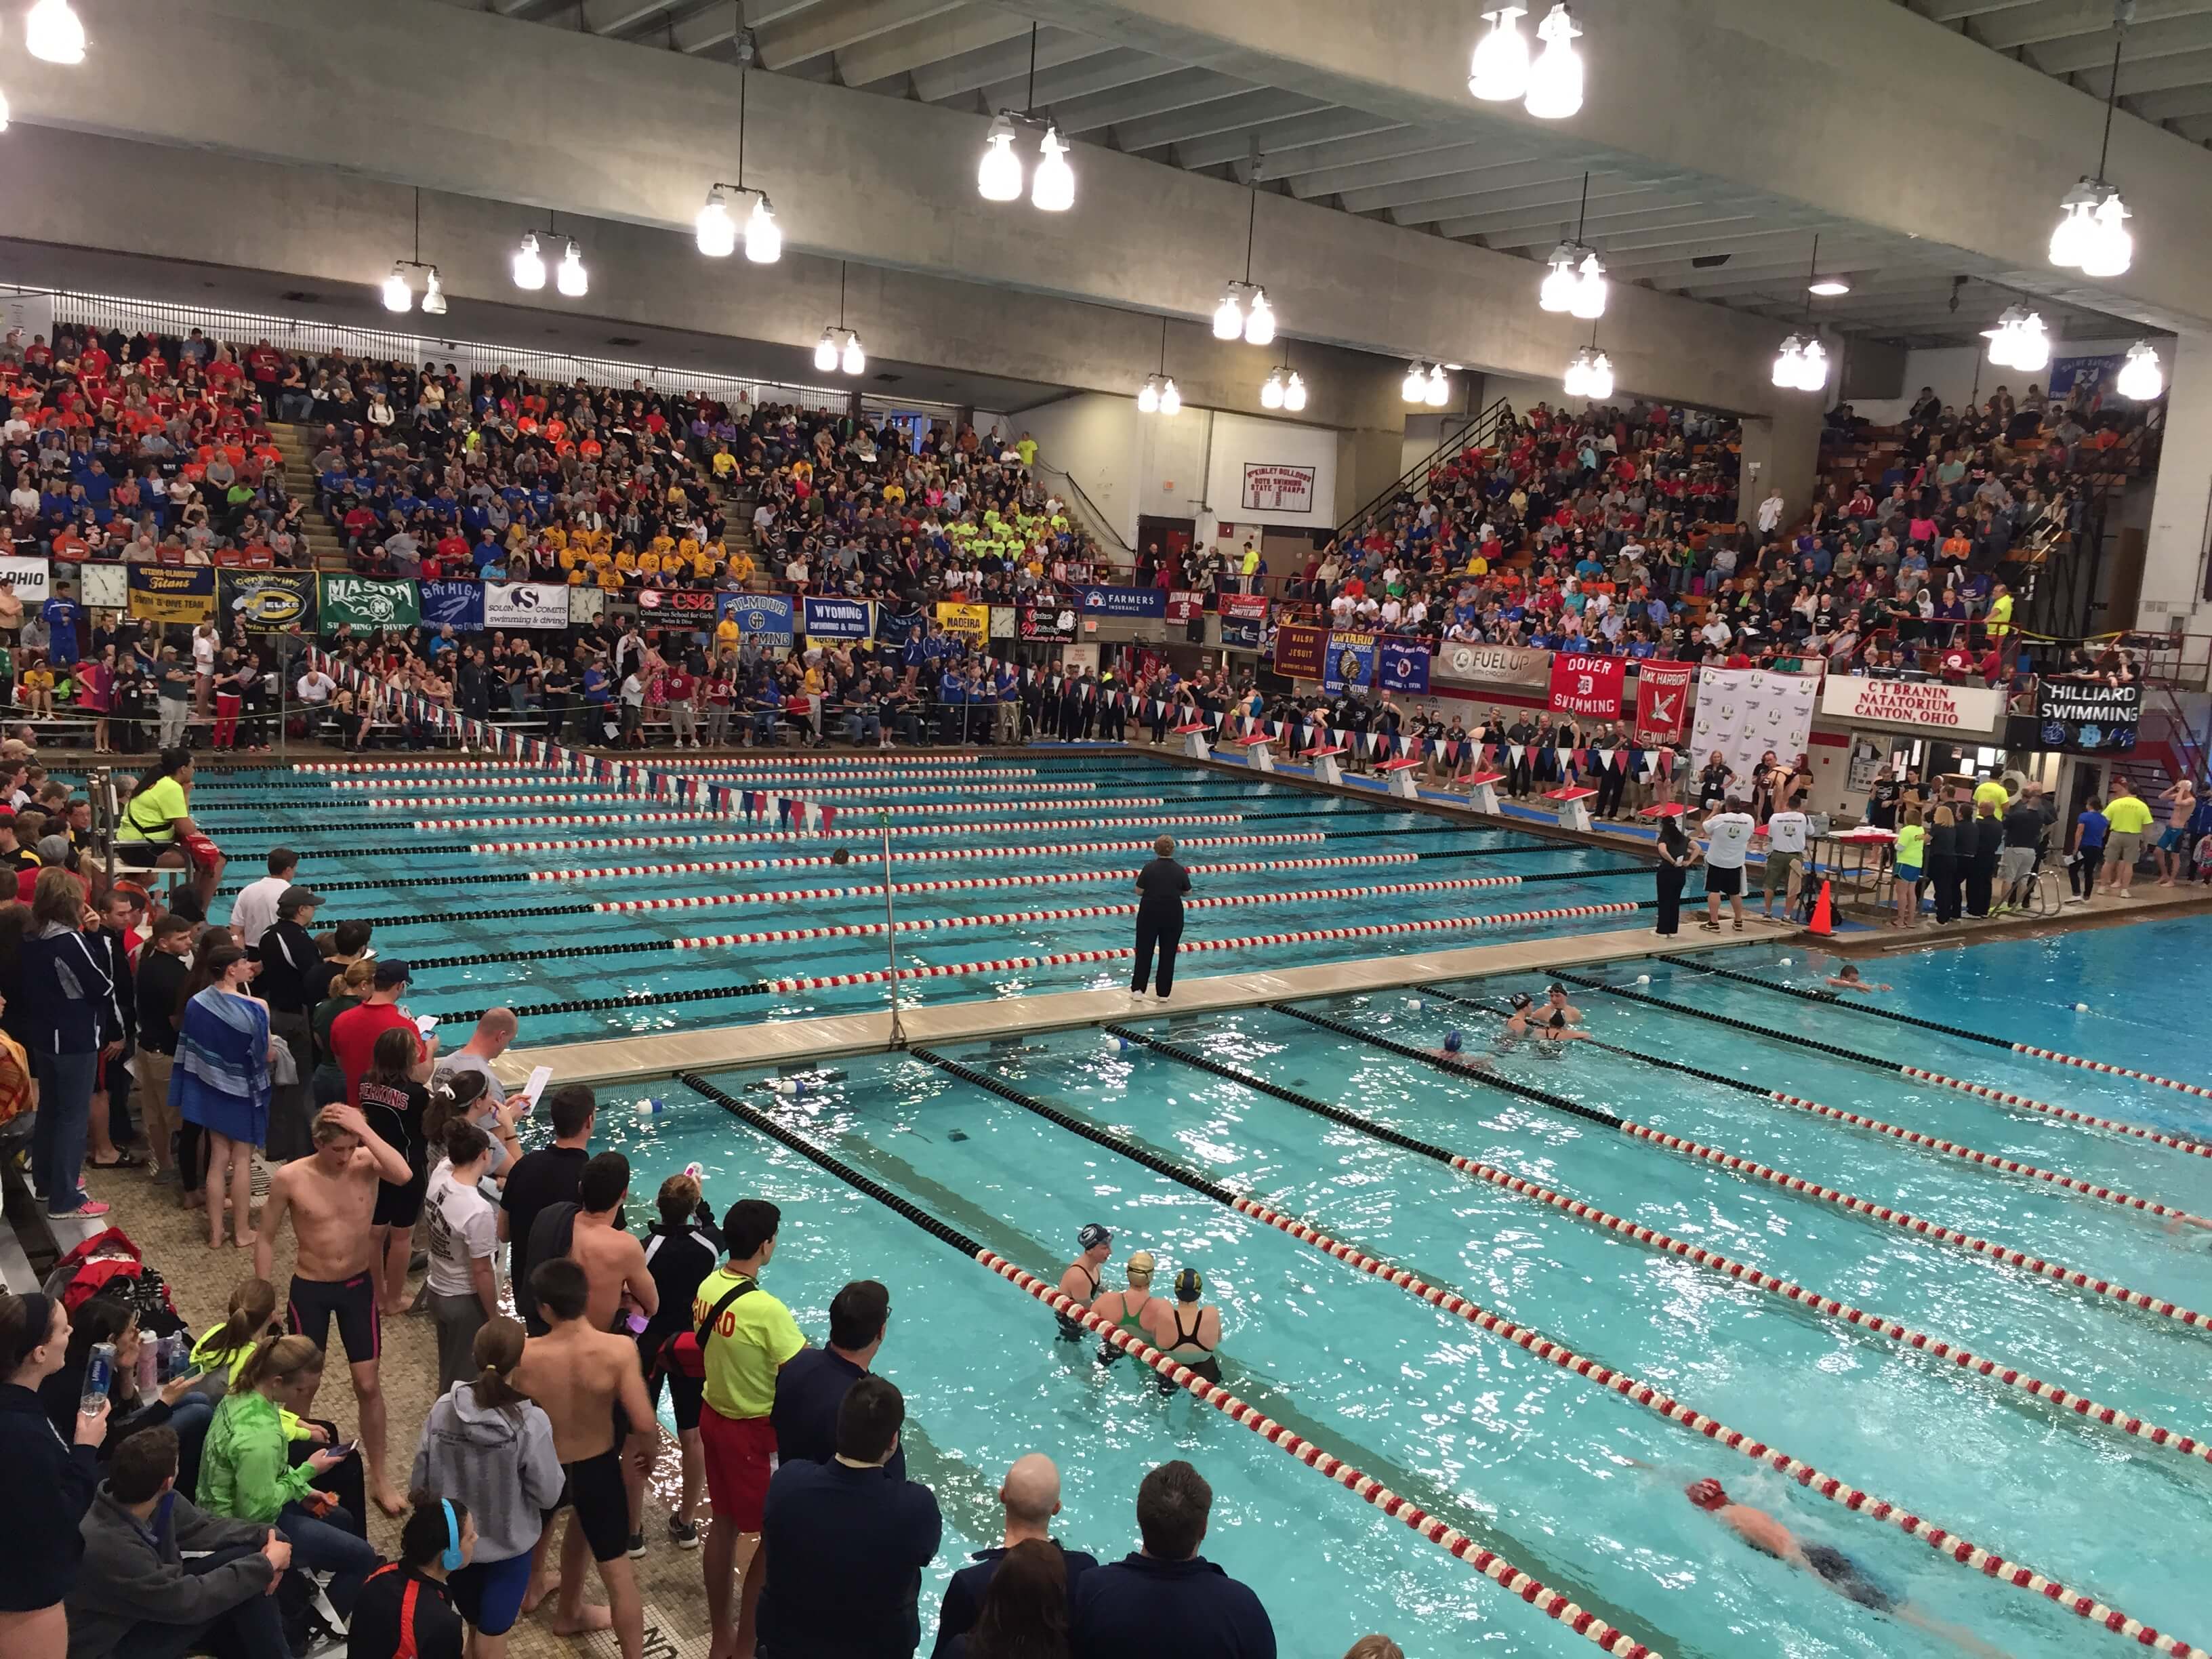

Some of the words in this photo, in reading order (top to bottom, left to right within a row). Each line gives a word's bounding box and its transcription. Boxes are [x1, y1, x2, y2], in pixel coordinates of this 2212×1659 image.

[1279, 468, 1311, 483] BULLDOGS
[1278, 486, 1305, 494] CHAMPS
[149, 577, 190, 589] Titans
[236, 574, 300, 587] Centerville
[327, 579, 413, 607] MASON
[421, 583, 445, 598] BAY
[448, 582, 481, 602] HIGH
[1109, 594, 1155, 605] FARMERS
[134, 595, 153, 606] SWIM
[165, 599, 182, 608] DIVE
[184, 600, 205, 609] TEAM
[672, 592, 716, 610] CSG
[815, 605, 862, 619] WYOMING
[489, 616, 531, 624] swimming
[540, 617, 566, 626] diving
[810, 621, 839, 631] SWIMMING
[947, 617, 980, 629] MADEIRA
[1292, 634, 1314, 643] WALSH
[1332, 632, 1374, 644] ONTARIO
[1288, 649, 1313, 658] JESUIT
[1330, 642, 1346, 650] HIGH
[1347, 643, 1372, 653] SCHOOL
[1473, 651, 1505, 670] FUEL
[1510, 654, 1530, 671] UP
[1568, 657, 1612, 675] DOVER
[1641, 670, 1656, 683] OAK
[1656, 672, 1687, 686] HARBOR
[1868, 681, 1877, 692] C
[1881, 682, 1889, 693] T
[1893, 683, 1949, 699] BRANIN
[2051, 684, 2136, 701] HILLIARD
[1555, 693, 1615, 712] SWIMMING
[1860, 693, 1956, 712] NATATORIUM
[1855, 704, 1917, 722] CANTON,
[1920, 711, 1959, 725] OHIO
[2041, 703, 2138, 722] SWIMMING
[359, 1082, 409, 1111] PERKINS
[692, 1296, 736, 1338] GURD
